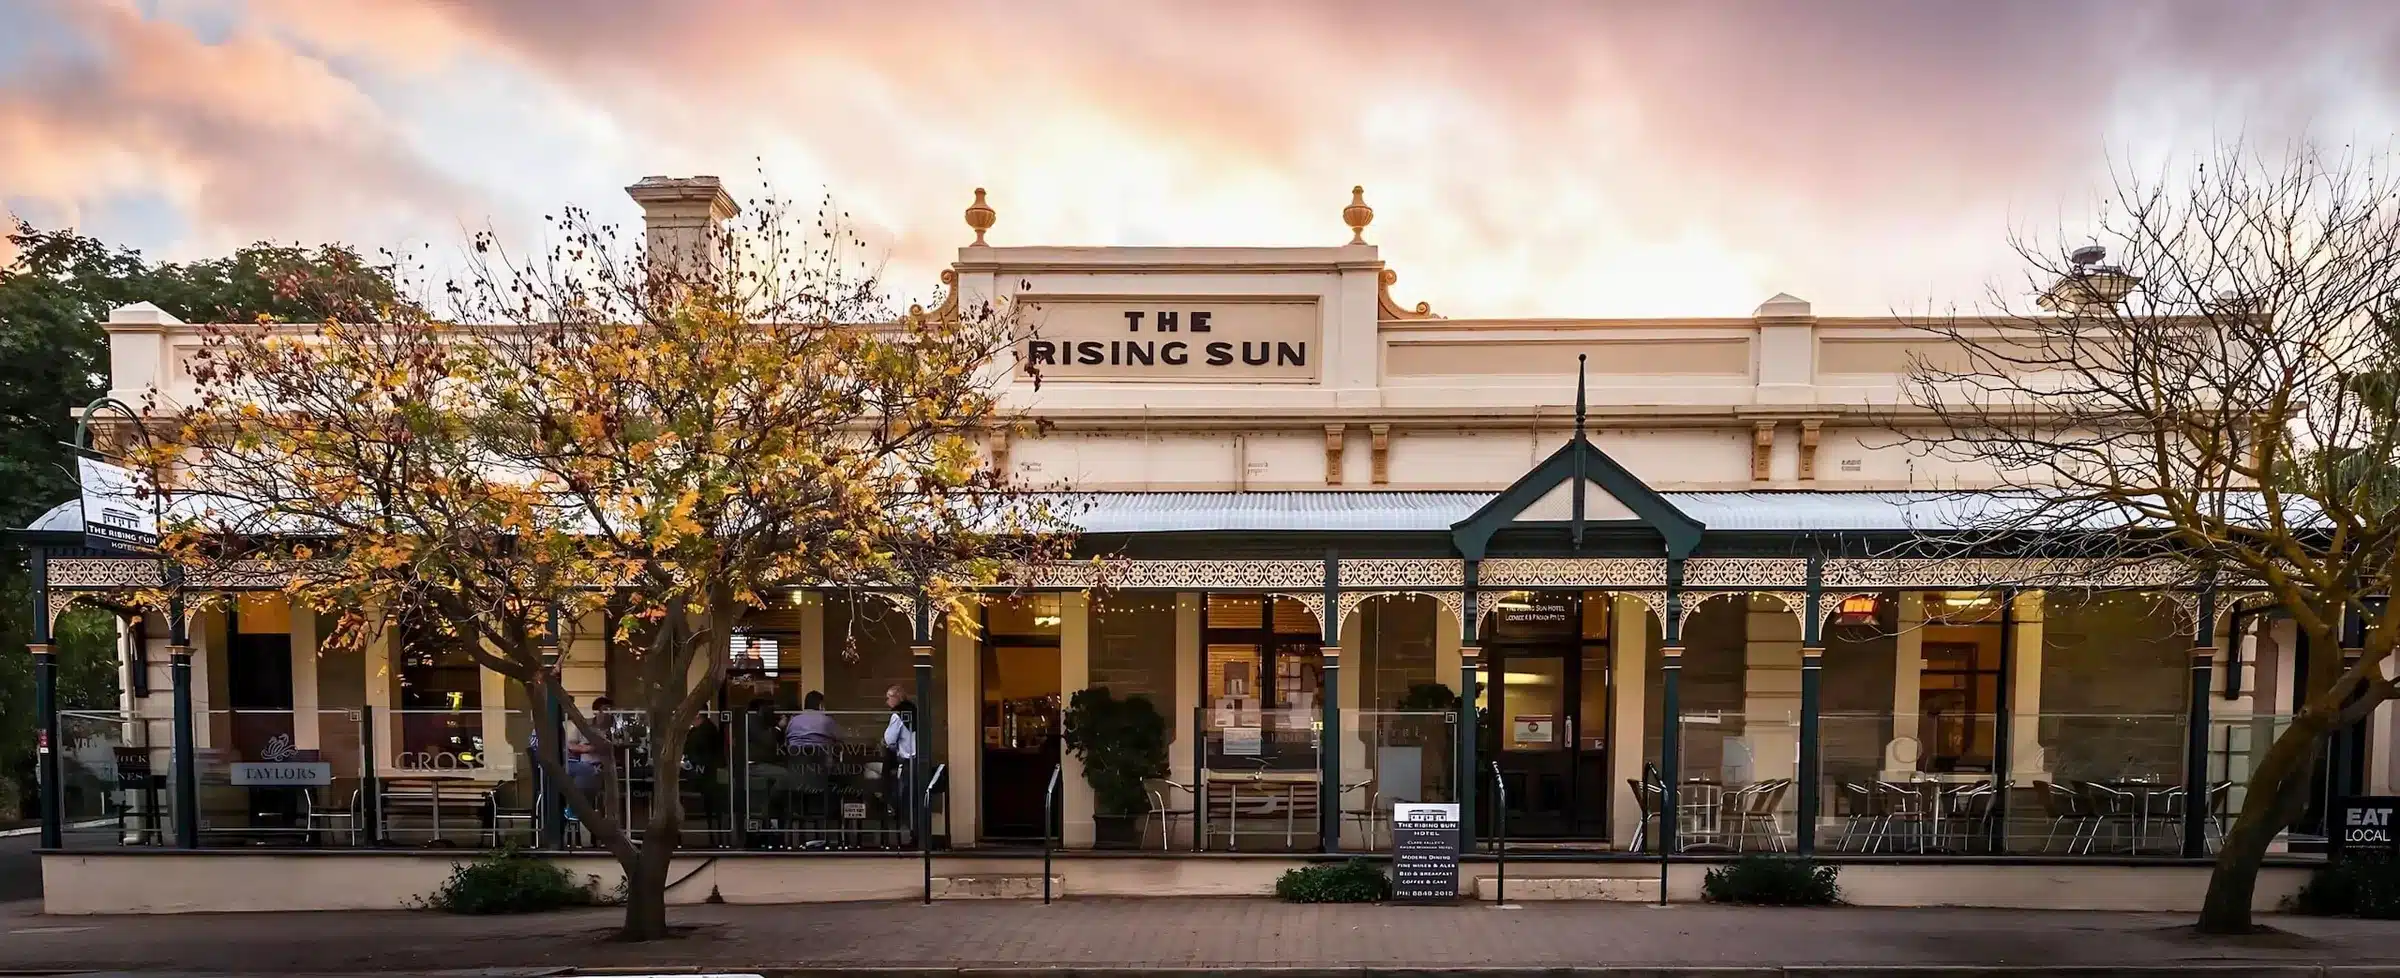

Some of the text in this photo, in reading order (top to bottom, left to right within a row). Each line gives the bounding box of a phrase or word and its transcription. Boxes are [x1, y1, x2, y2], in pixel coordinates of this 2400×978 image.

[1124, 311, 1212, 332] THE
[1028, 340, 1305, 366] RISING SUN
[88, 524, 107, 535] THE
[108, 528, 137, 541] RISING
[244, 767, 317, 780] TAYLORS
[2346, 808, 2393, 826] EAT
[2345, 829, 2391, 842] LOCAL
